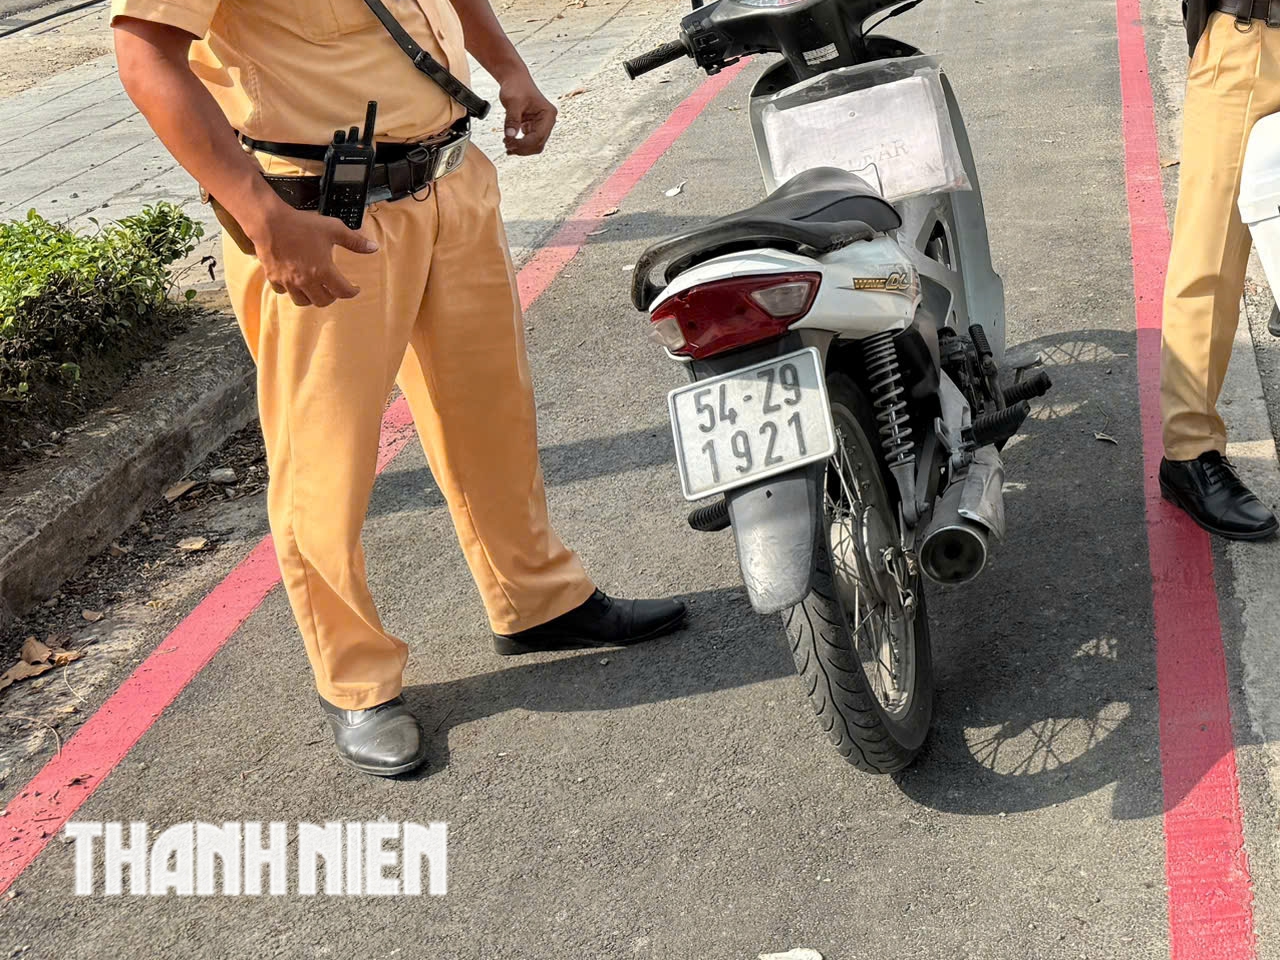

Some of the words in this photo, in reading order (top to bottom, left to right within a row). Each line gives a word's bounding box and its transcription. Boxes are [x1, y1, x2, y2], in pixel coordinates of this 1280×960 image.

[854, 279, 887, 289] WAVE
[693, 363, 802, 433] 54-Z9
[701, 412, 807, 484] 1921
